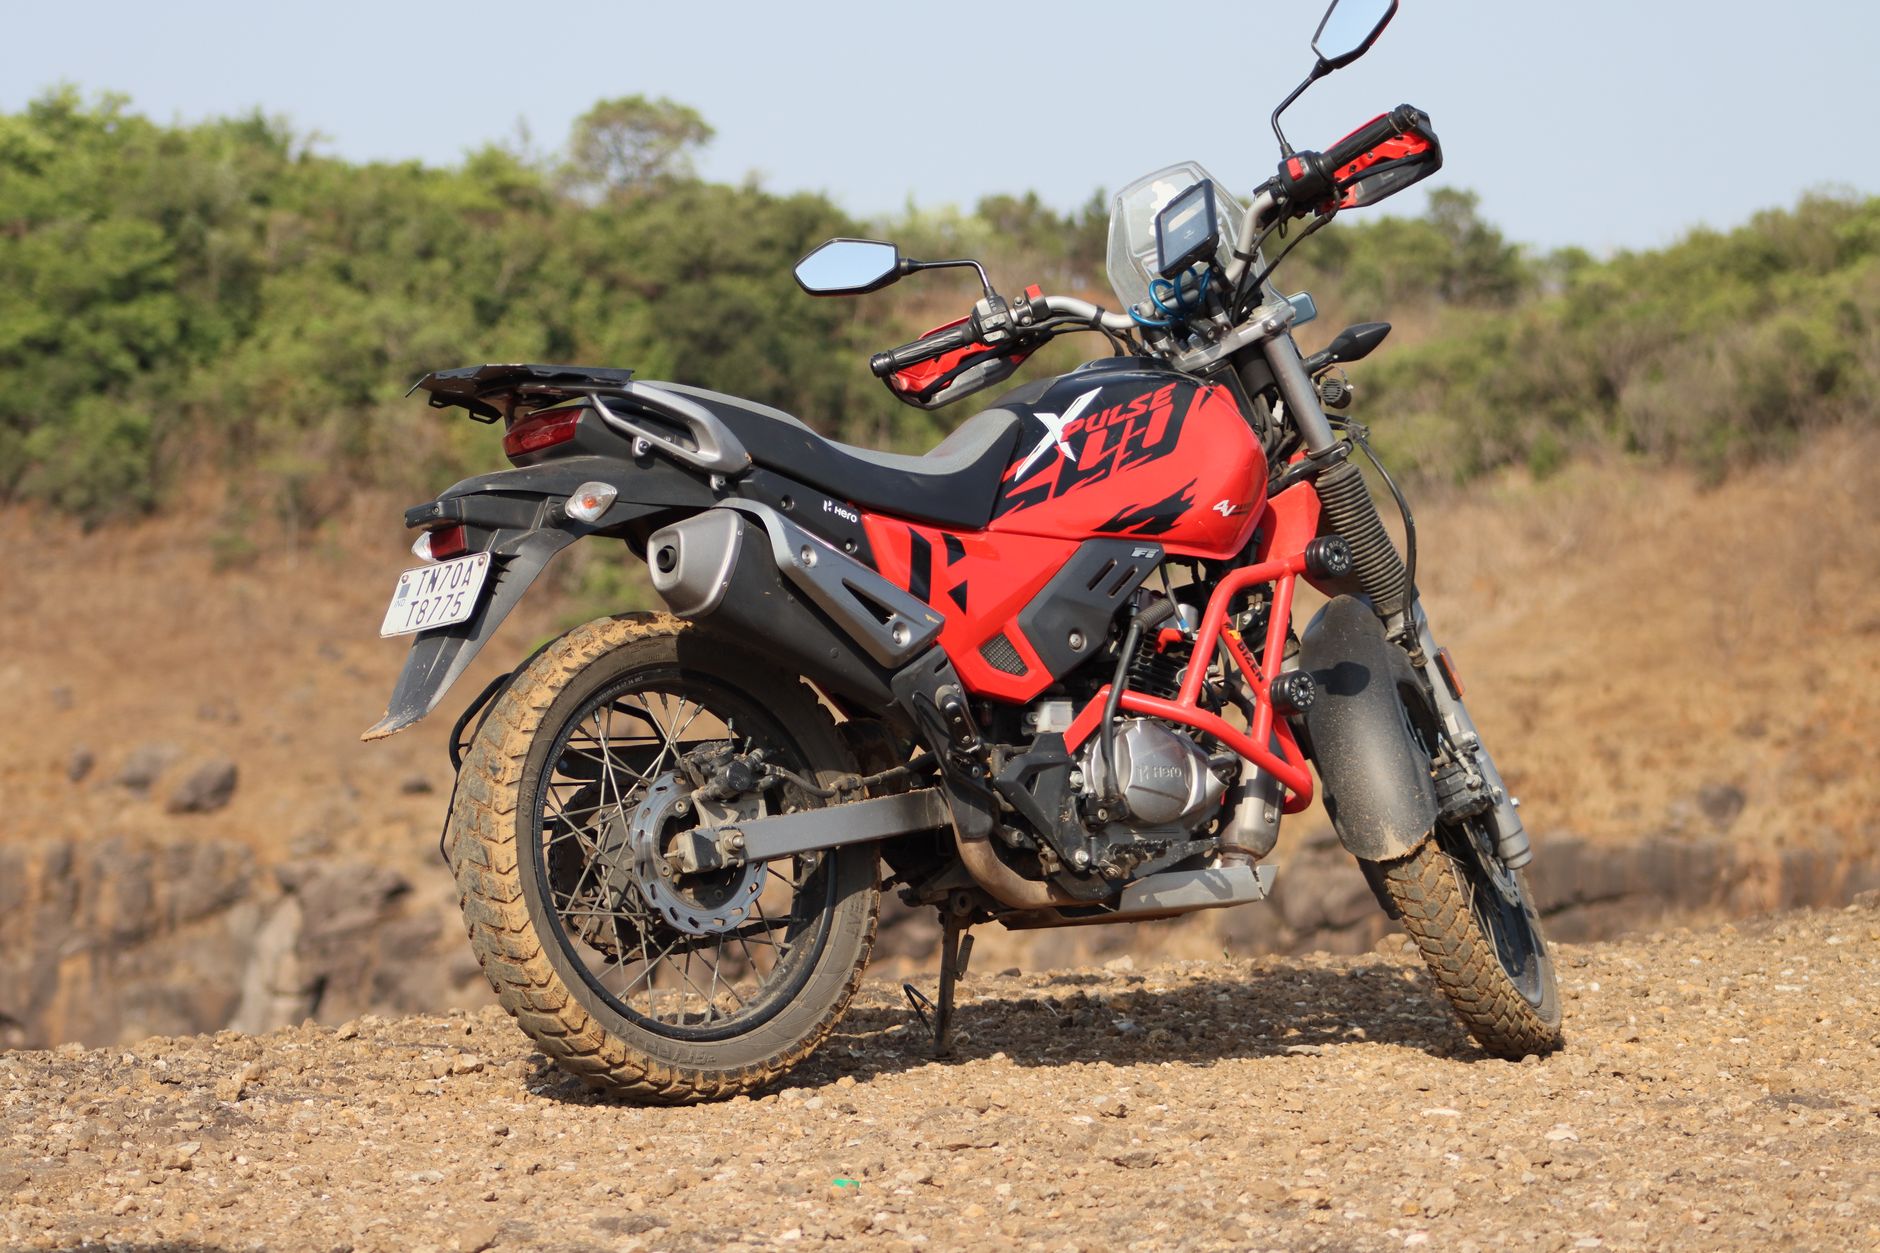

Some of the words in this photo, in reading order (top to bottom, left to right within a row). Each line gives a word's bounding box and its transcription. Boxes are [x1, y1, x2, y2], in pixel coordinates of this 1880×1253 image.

[834, 506, 858, 523] Hero
[1212, 499, 1237, 517] 4V
[416, 560, 474, 596] TN70A
[405, 591, 465, 627] T8775
